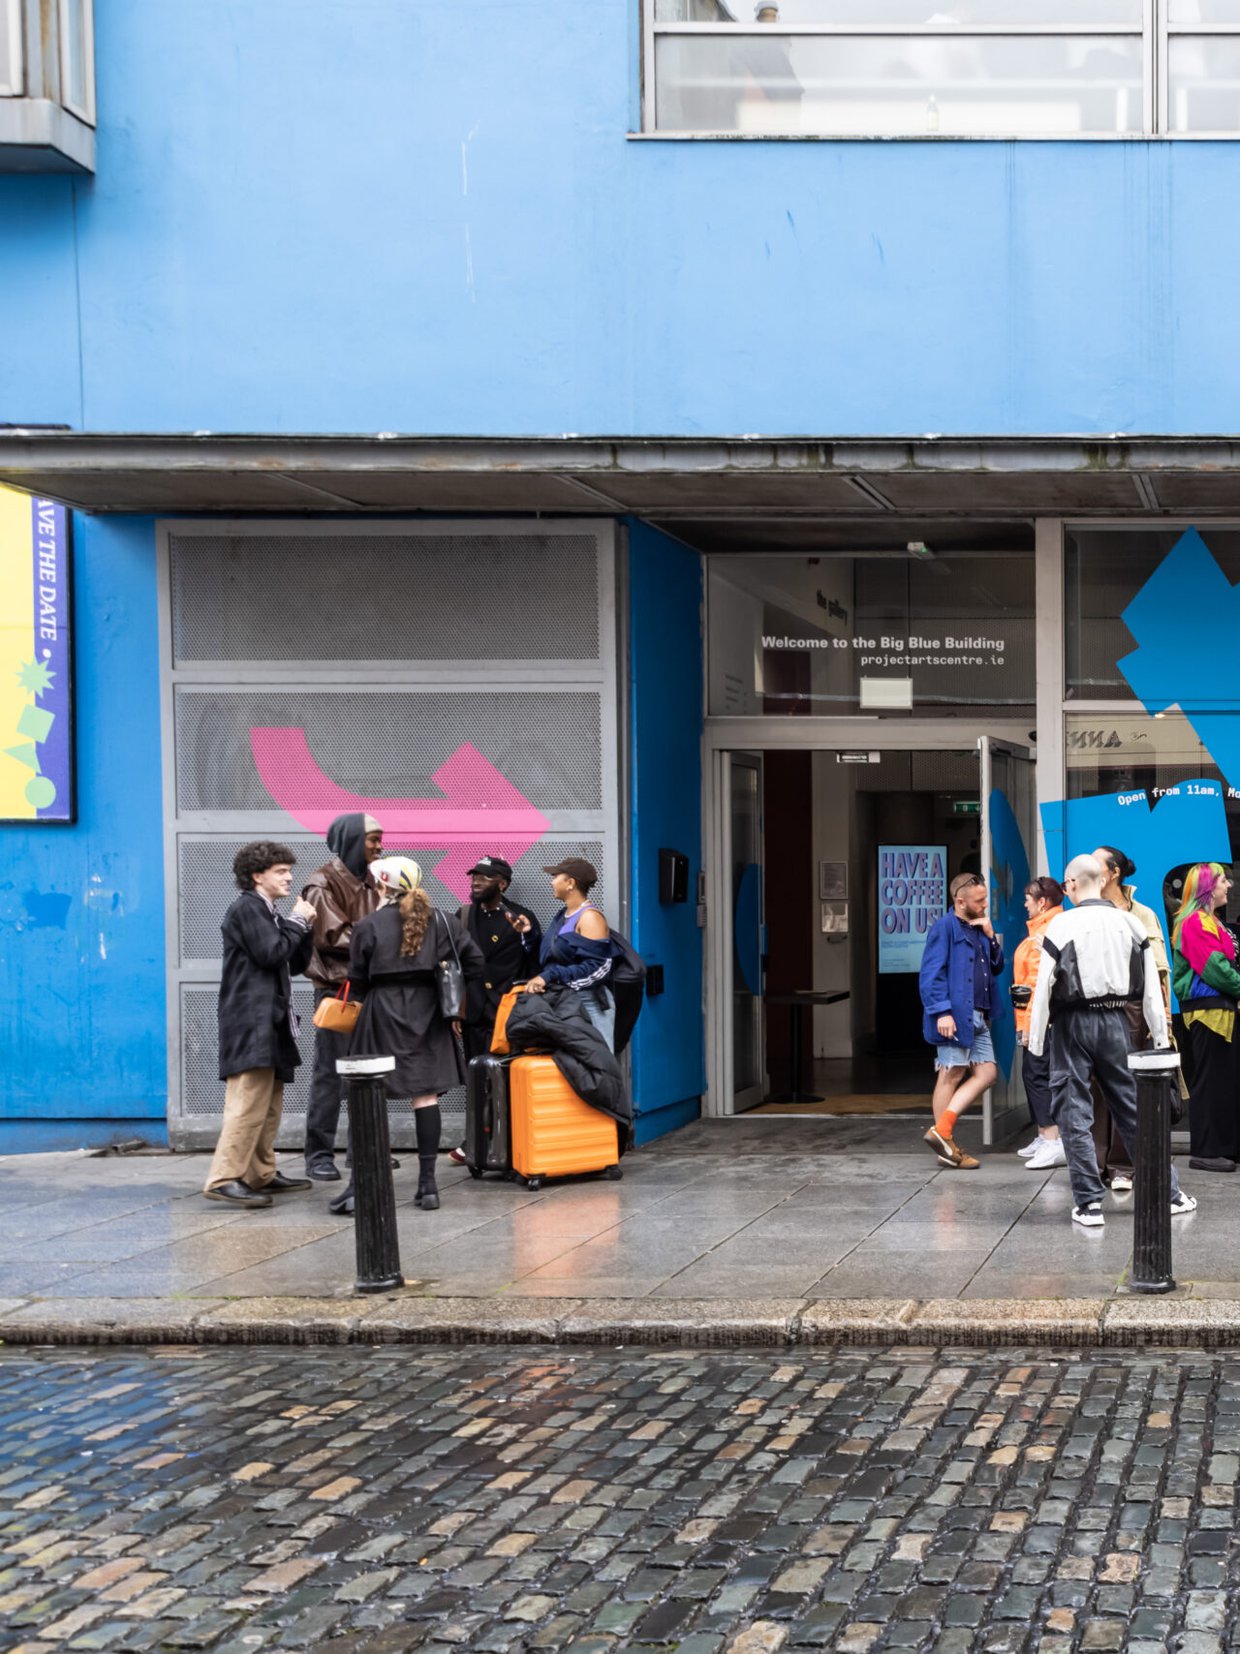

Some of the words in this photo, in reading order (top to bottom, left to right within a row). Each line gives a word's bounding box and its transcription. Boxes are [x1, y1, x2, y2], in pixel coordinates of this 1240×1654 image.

[39, 540, 56, 583] THE
[40, 585, 57, 641] DATE
[761, 636, 828, 648] Welcome
[832, 637, 848, 648] to
[852, 636, 876, 648] the
[880, 636, 904, 651] Big
[908, 636, 941, 649] Blue
[945, 636, 1005, 651] Building
[861, 654, 1005, 667] projectartscentre.ie
[1117, 792, 1146, 806] Open
[1151, 787, 1180, 798] from
[1187, 784, 1220, 797] 11am,
[881, 852, 929, 879] HAVE
[930, 852, 944, 879] A
[881, 879, 944, 906] COFFEE
[880, 907, 911, 935] ON
